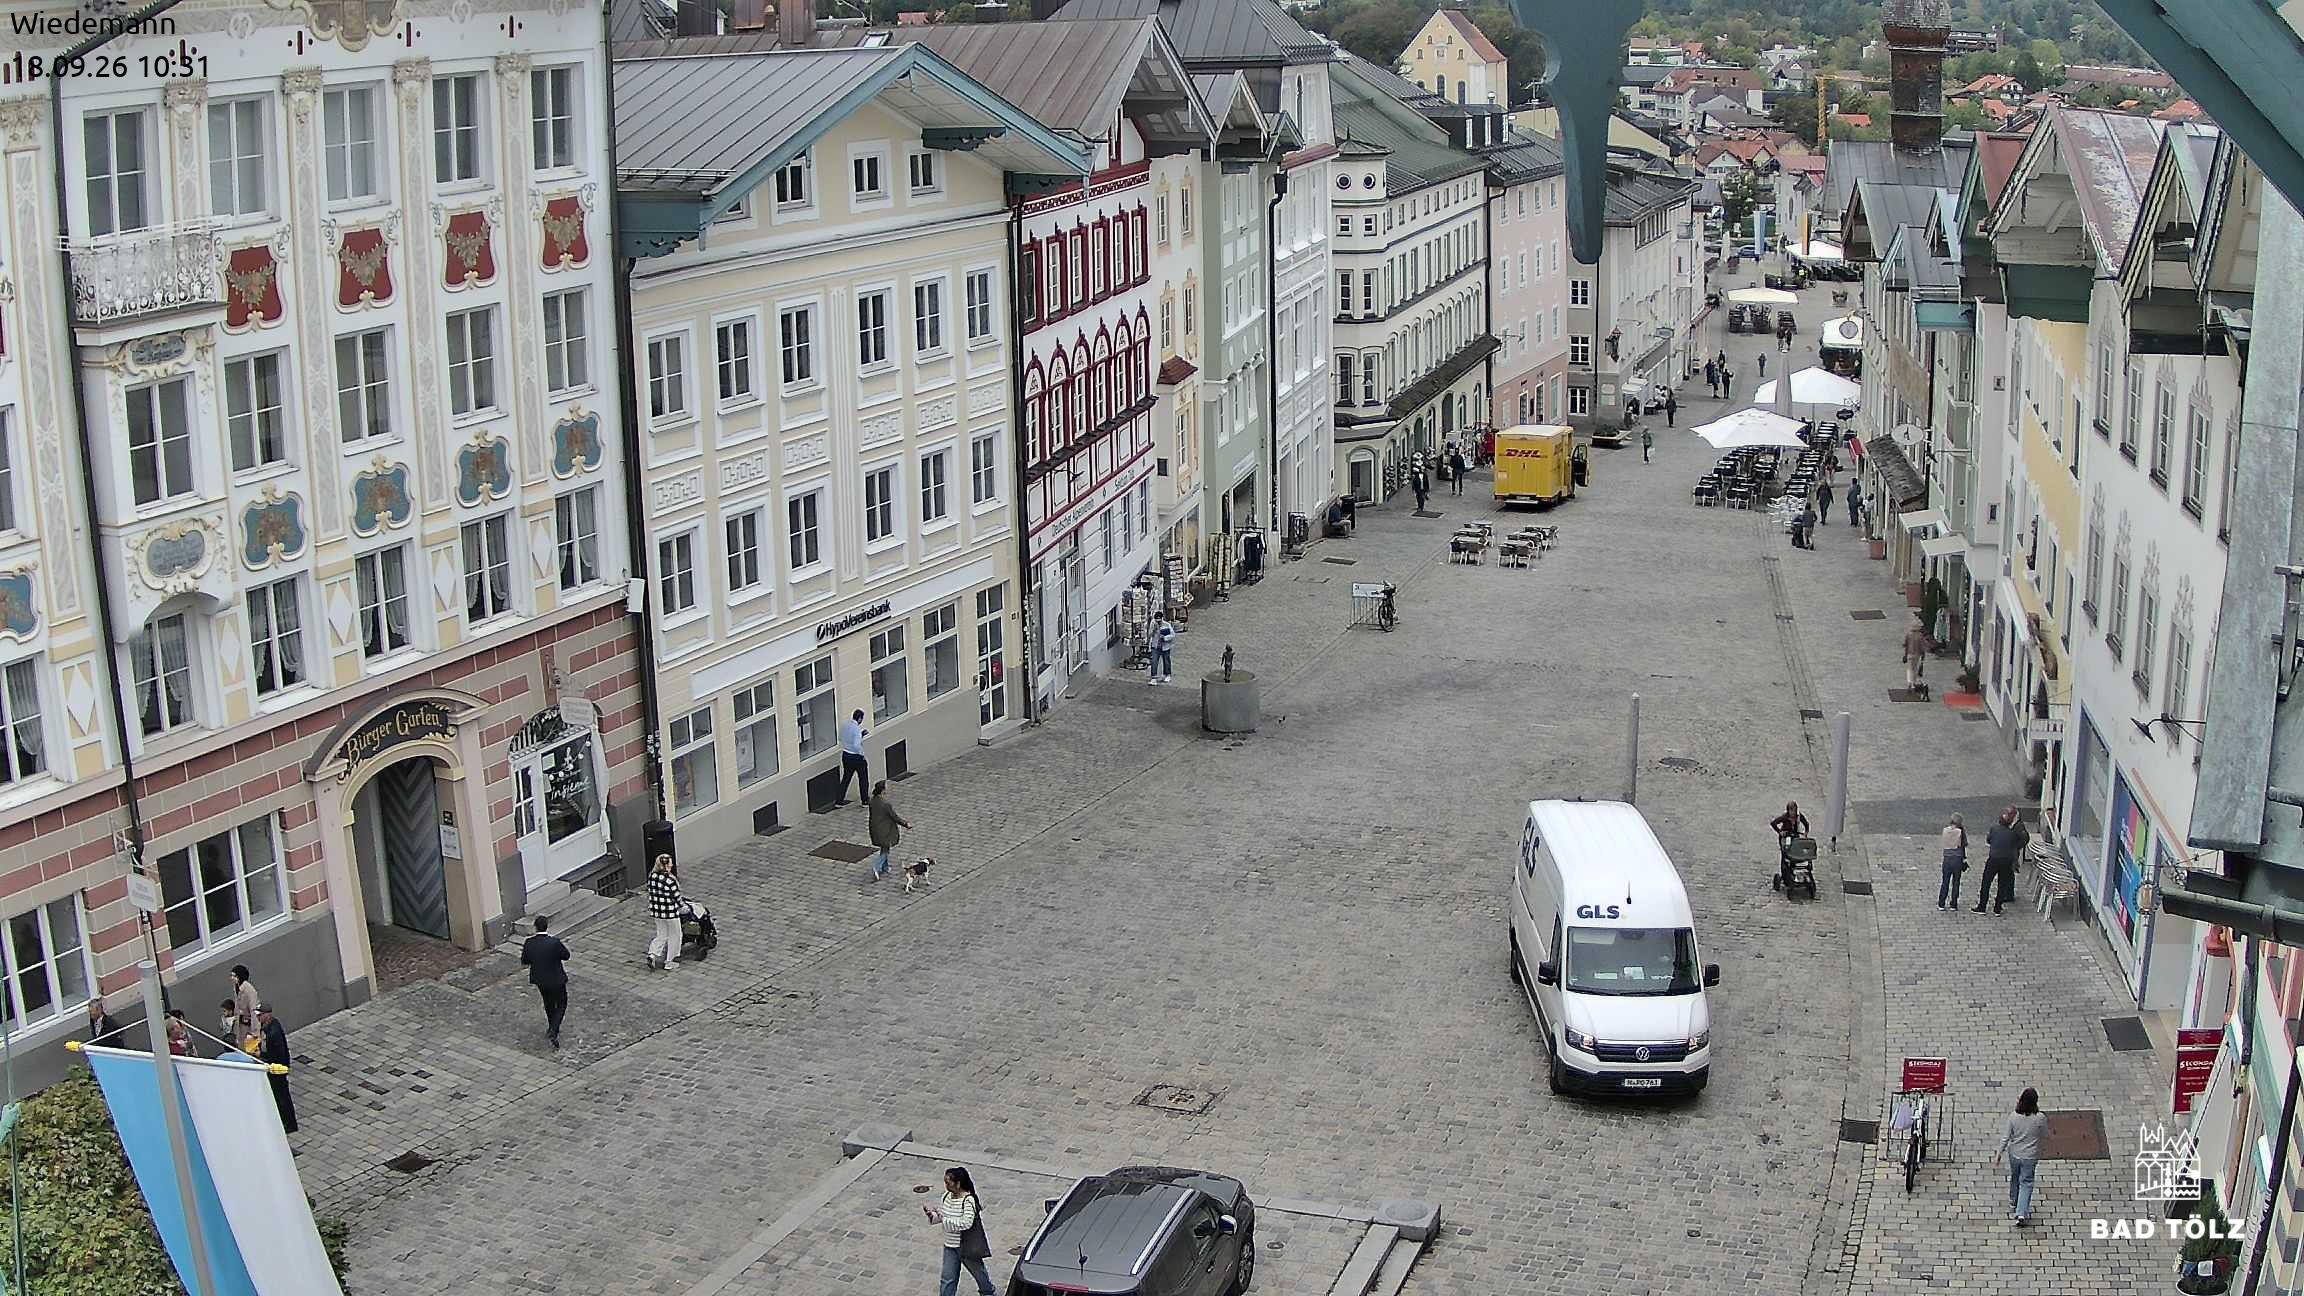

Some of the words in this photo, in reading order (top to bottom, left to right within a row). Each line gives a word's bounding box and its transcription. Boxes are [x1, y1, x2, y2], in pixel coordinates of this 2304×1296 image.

[1505, 449, 1540, 458] DHL
[825, 599, 892, 637] HypoVereinsbank
[347, 720, 392, 768] Bürger
[395, 704, 442, 736] Garten
[1522, 816, 1540, 879] GLS
[1576, 904, 1620, 919] GLS
